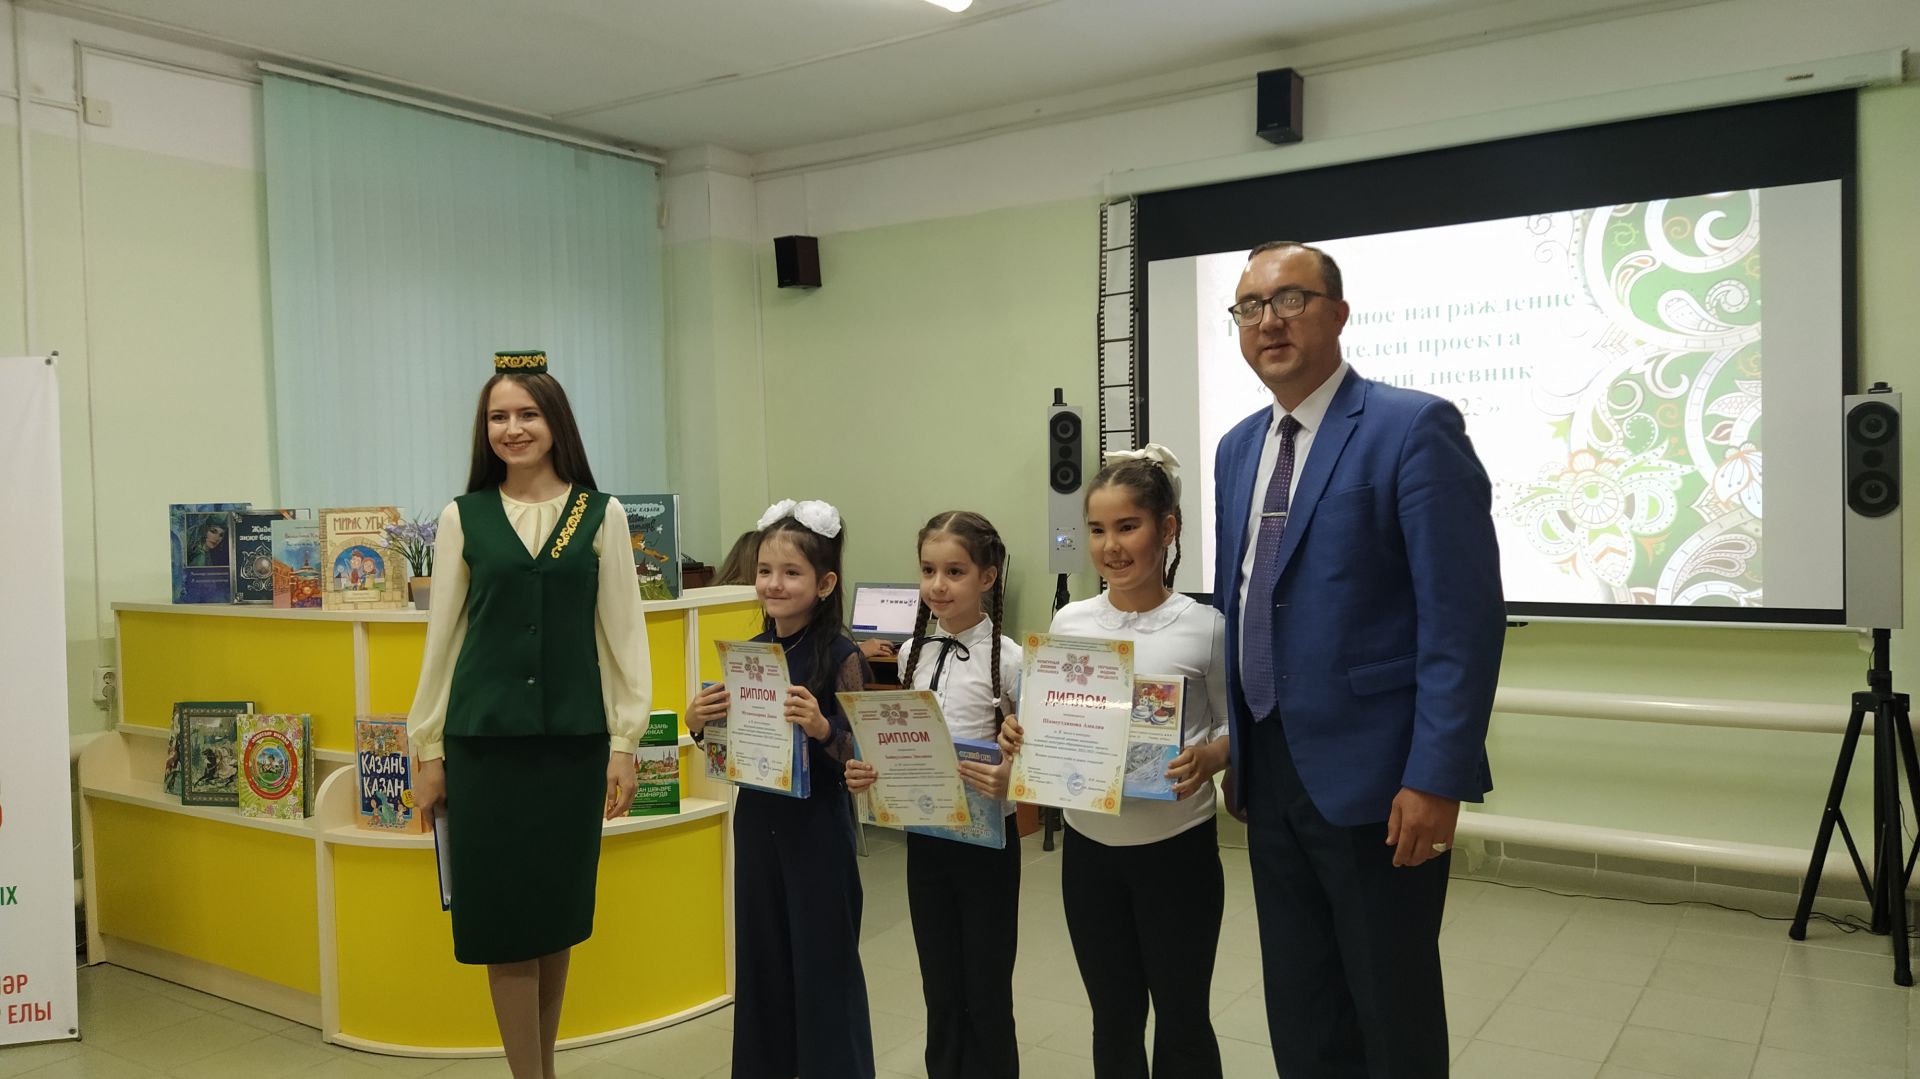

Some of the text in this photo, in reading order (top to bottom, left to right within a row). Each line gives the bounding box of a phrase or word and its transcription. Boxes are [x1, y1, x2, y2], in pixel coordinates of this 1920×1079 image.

[1418, 332, 1521, 358] проекта
[1424, 365, 1534, 387] дневник
[333, 516, 361, 531] МИРАС
[740, 686, 777, 702] ДИПЛОМ
[1045, 690, 1107, 710] ДИПЛОМ
[878, 731, 931, 746] ДИПЛОМ
[361, 752, 406, 775] КАЗАНЬ
[363, 776, 405, 799] КАЗАН
[8, 1001, 52, 1025] ЕЛЫ
